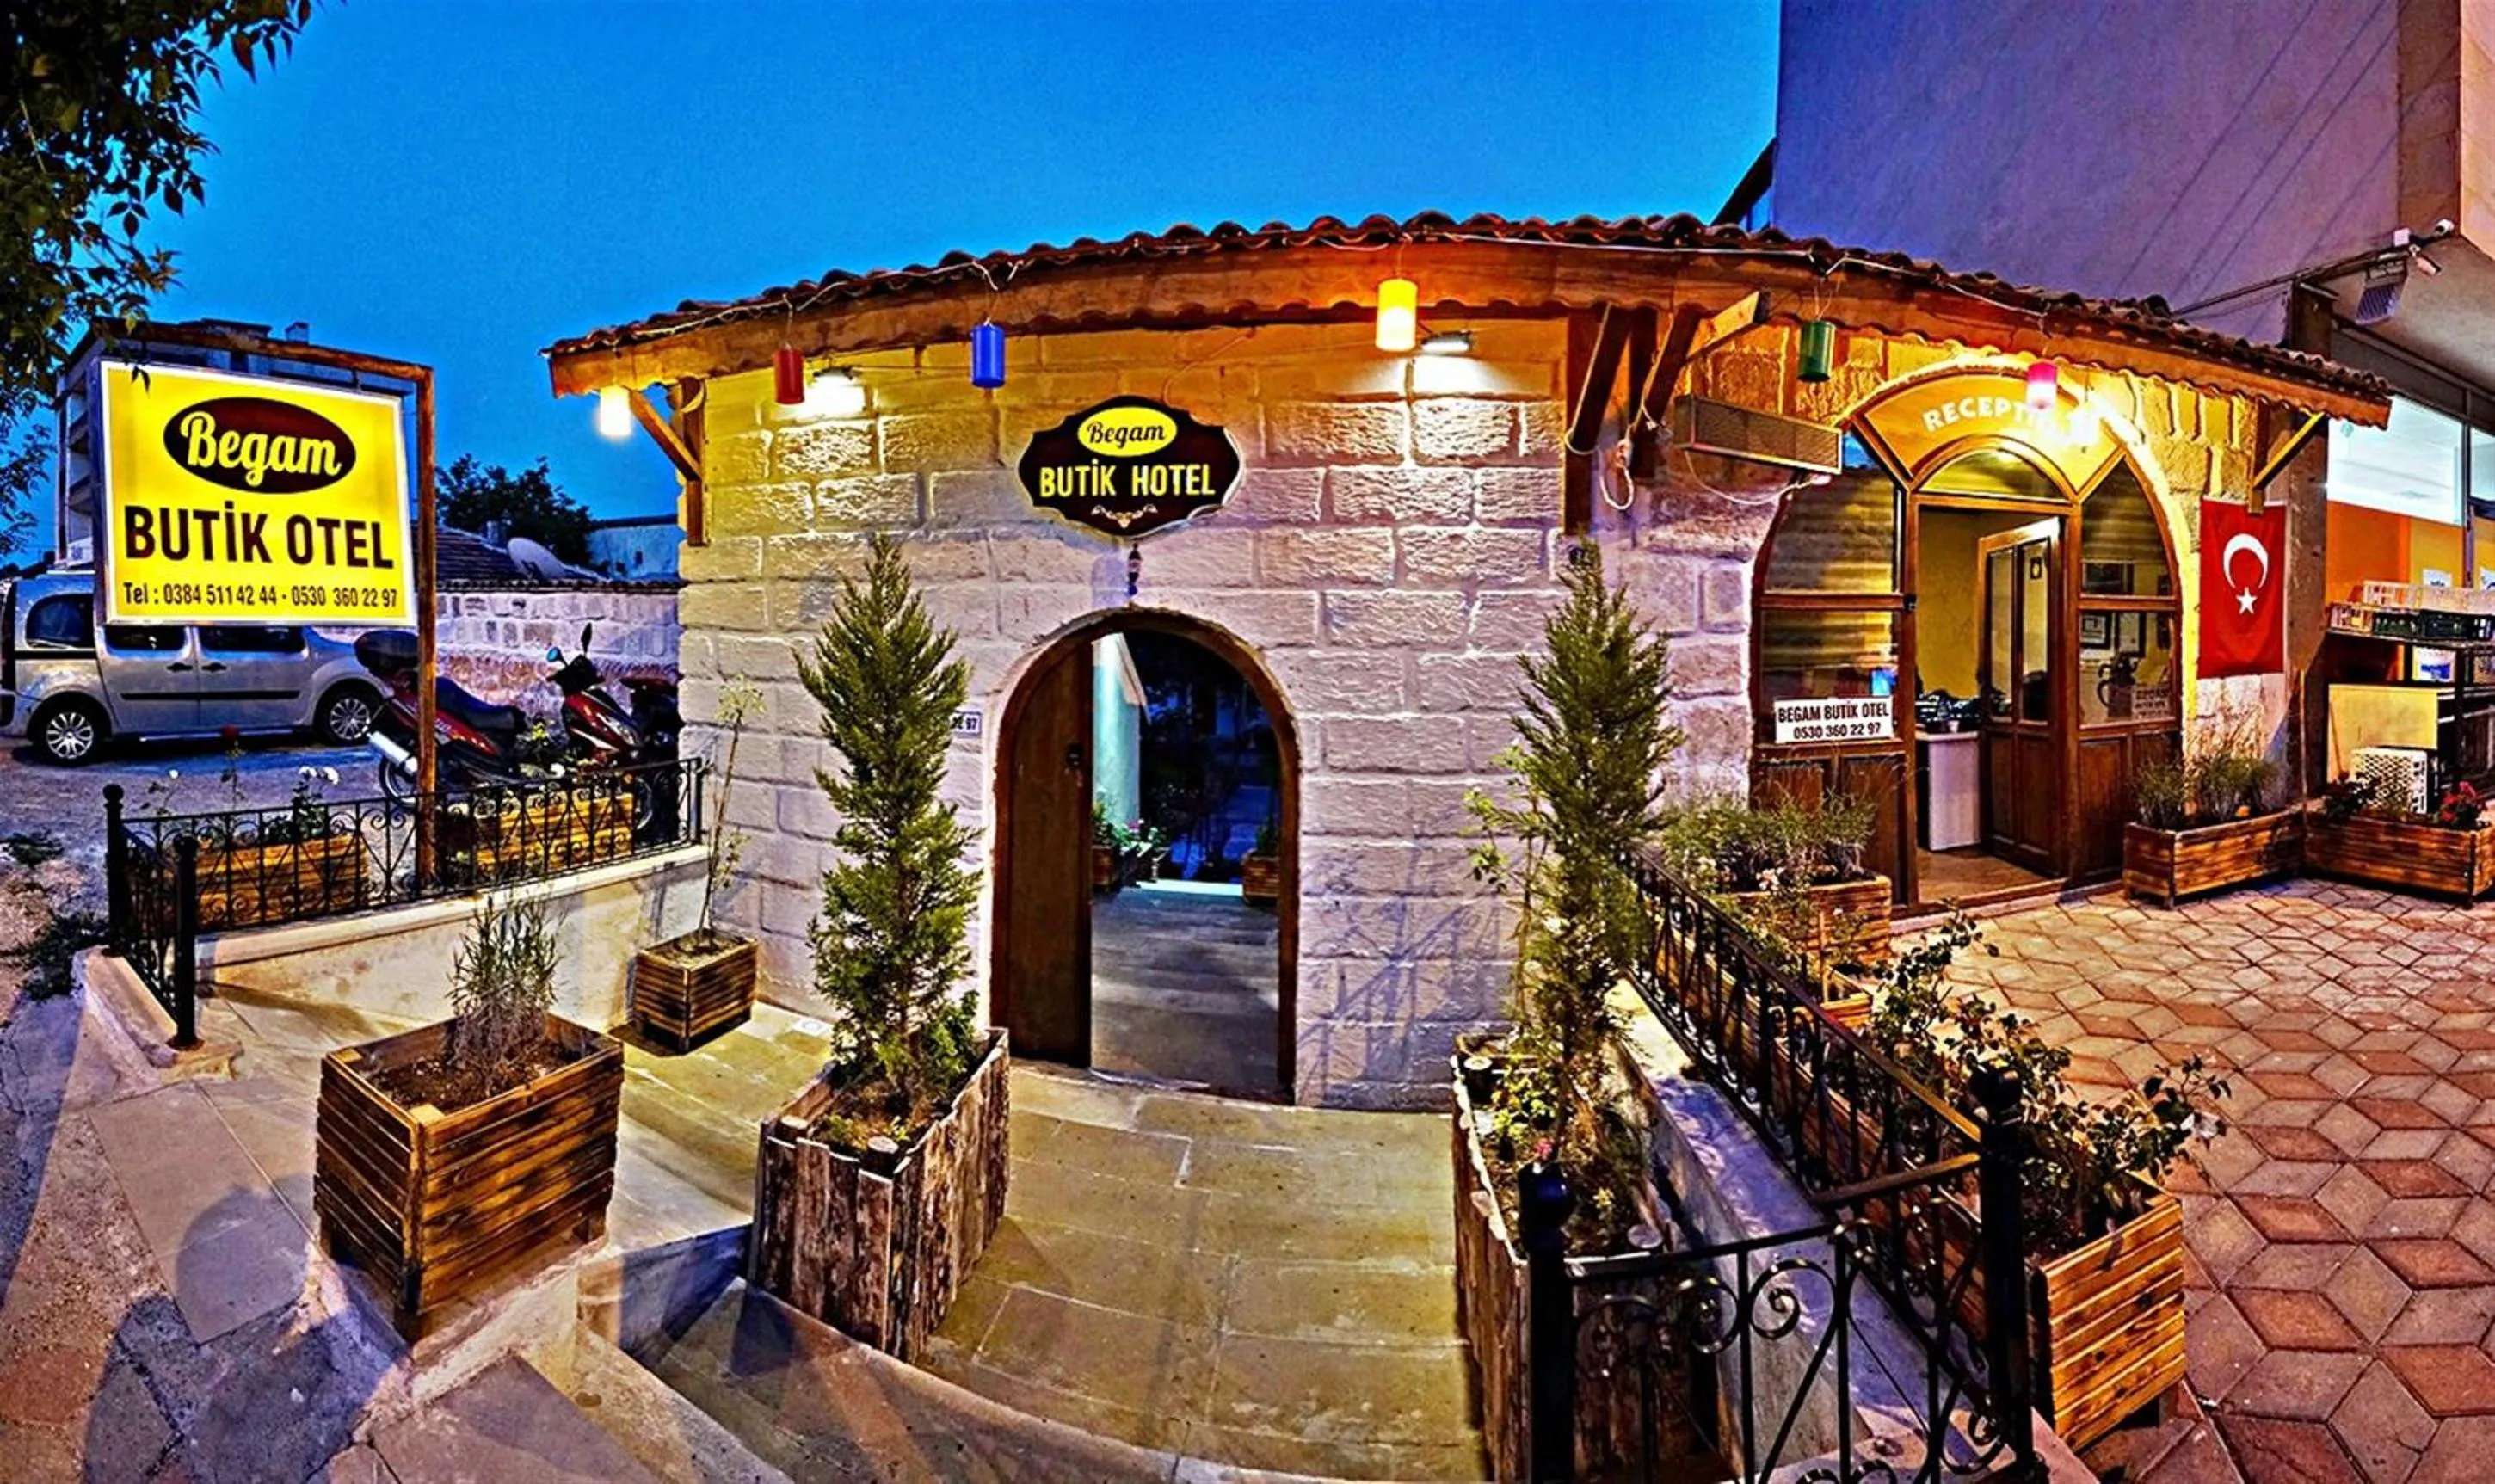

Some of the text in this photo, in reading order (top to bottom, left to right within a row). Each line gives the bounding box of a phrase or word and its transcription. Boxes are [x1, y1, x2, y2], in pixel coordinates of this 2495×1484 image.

[181, 410, 342, 487] Begam
[1087, 421, 1167, 449] Begam
[1039, 458, 1217, 497] BUTİK HOTEL
[124, 501, 395, 569] BUTİK OTEL
[163, 582, 202, 606] 0384
[259, 585, 277, 605] 44
[291, 585, 327, 607] 0530
[332, 587, 359, 607] 360
[361, 588, 379, 607] 22
[381, 588, 398, 607] 97
[1777, 705, 1821, 724] BEGAM
[1861, 702, 1890, 718] OTEL
[1793, 724, 1823, 739] 0530
[1850, 723, 1865, 736] 22
[1867, 721, 1882, 734] 97
